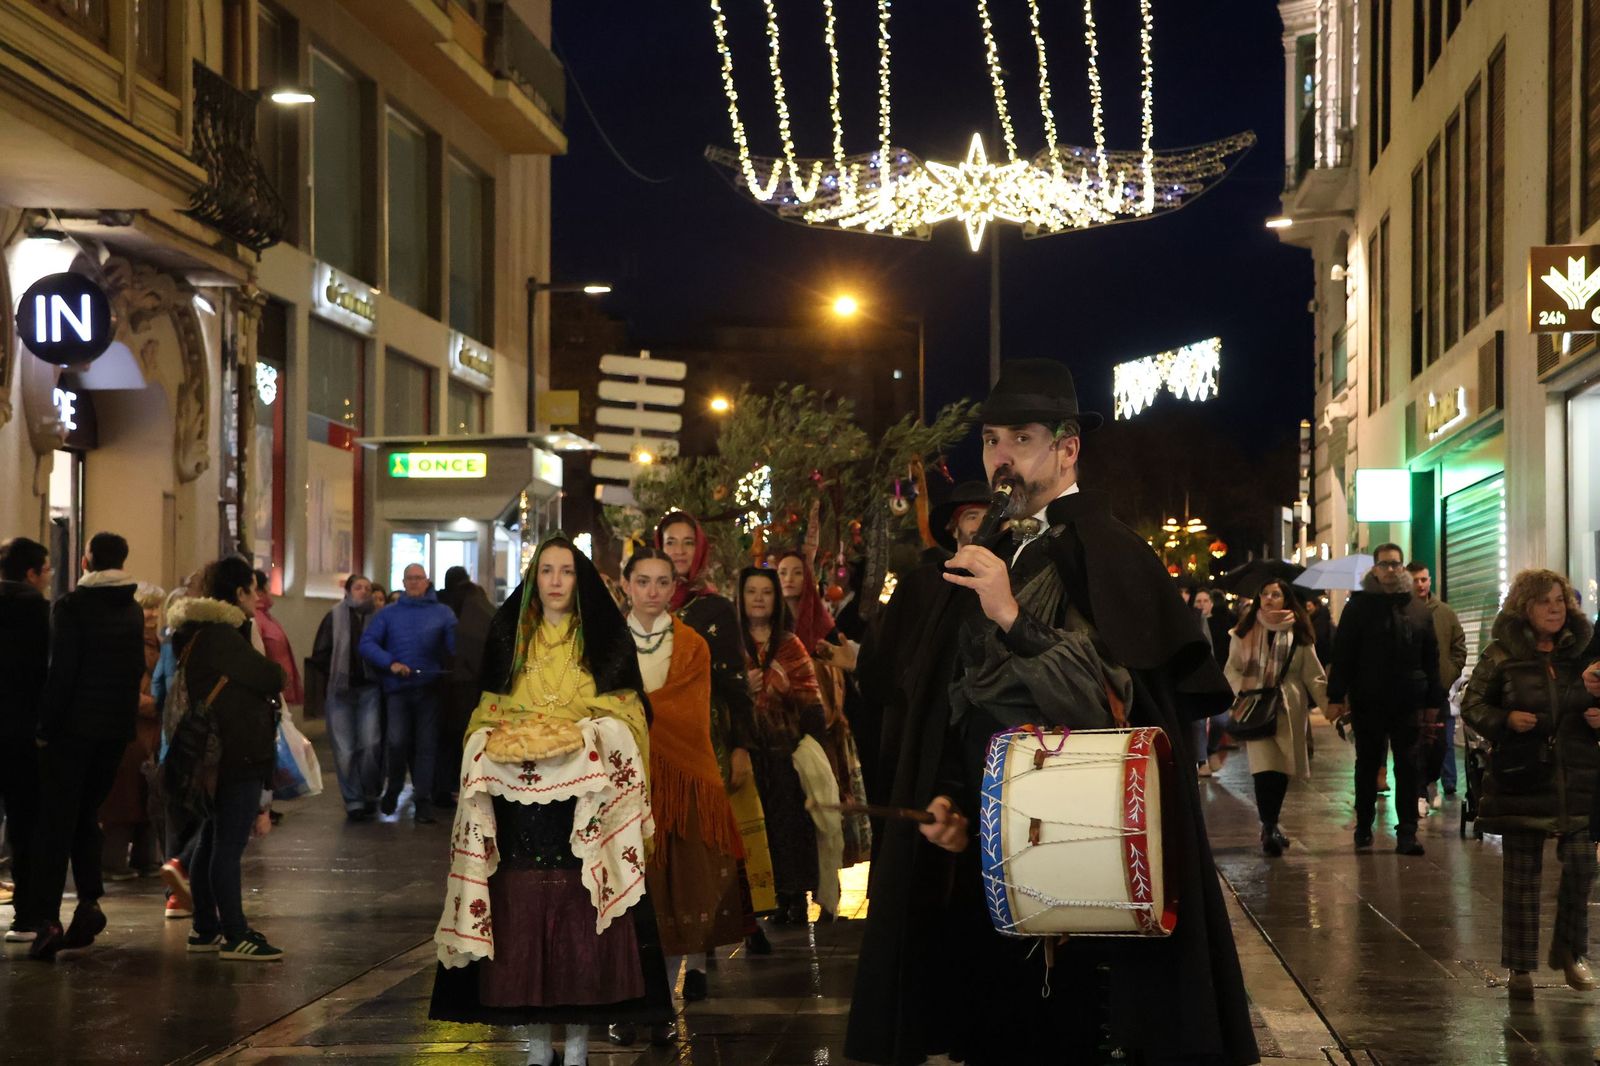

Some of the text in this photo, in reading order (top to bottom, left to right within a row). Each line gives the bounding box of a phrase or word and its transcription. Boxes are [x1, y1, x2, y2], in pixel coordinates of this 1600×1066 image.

[35, 294, 92, 343] IN
[1538, 310, 1566, 325] 24h
[418, 459, 477, 472] ONCE
